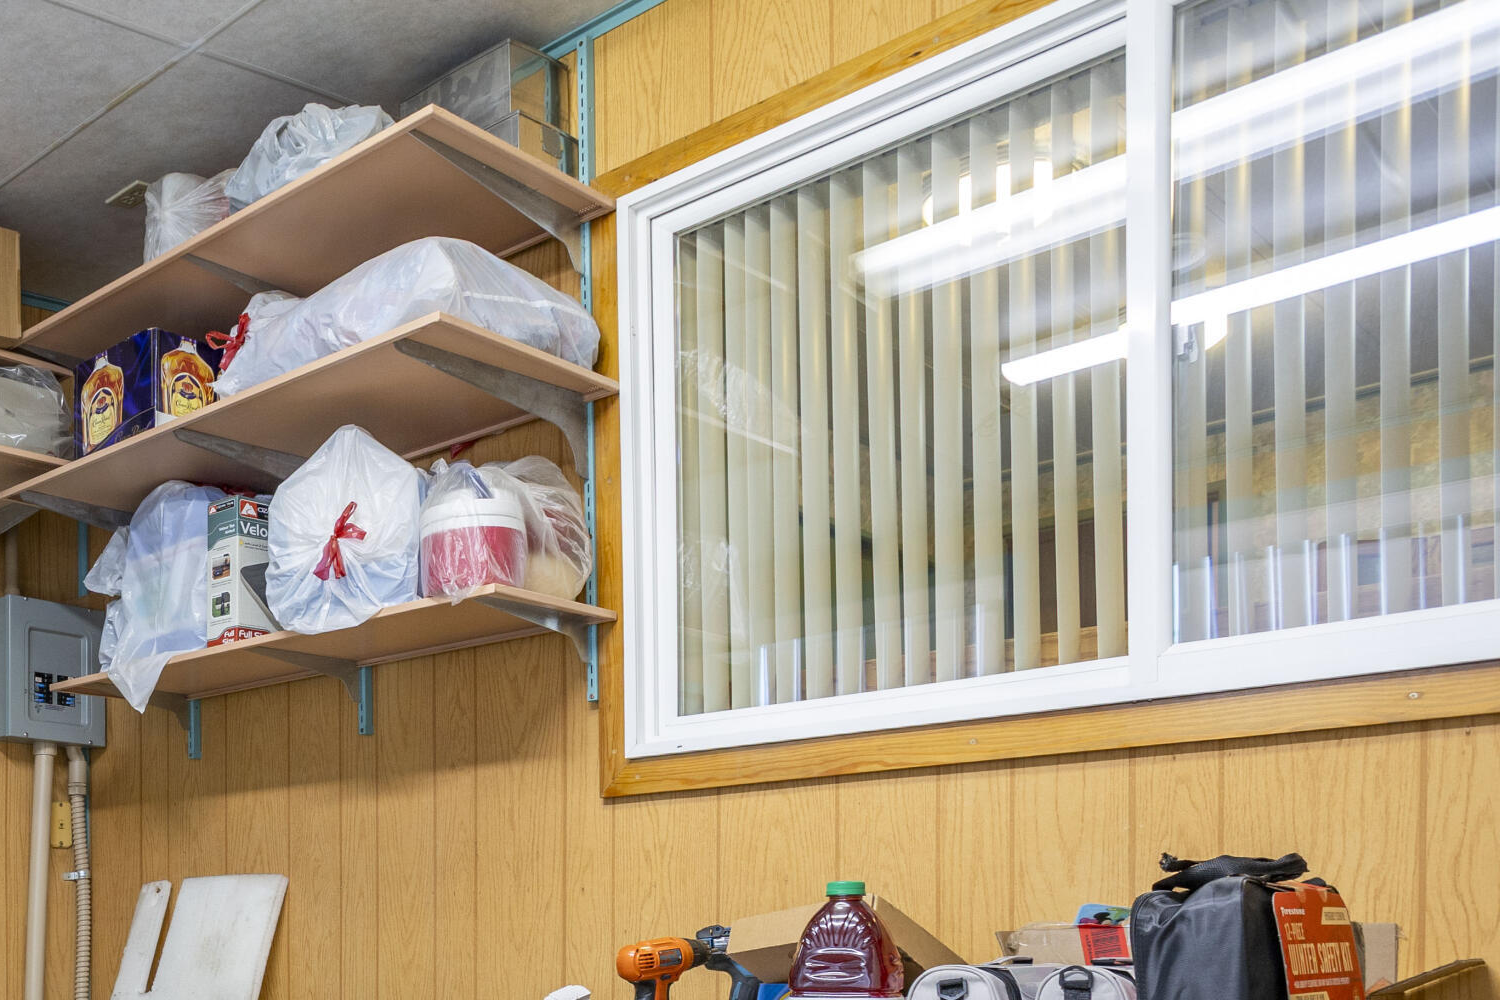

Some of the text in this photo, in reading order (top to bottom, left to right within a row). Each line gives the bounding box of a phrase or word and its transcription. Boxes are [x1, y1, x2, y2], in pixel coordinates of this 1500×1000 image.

[1288, 941, 1354, 976] WINTER SAFETY KIT
